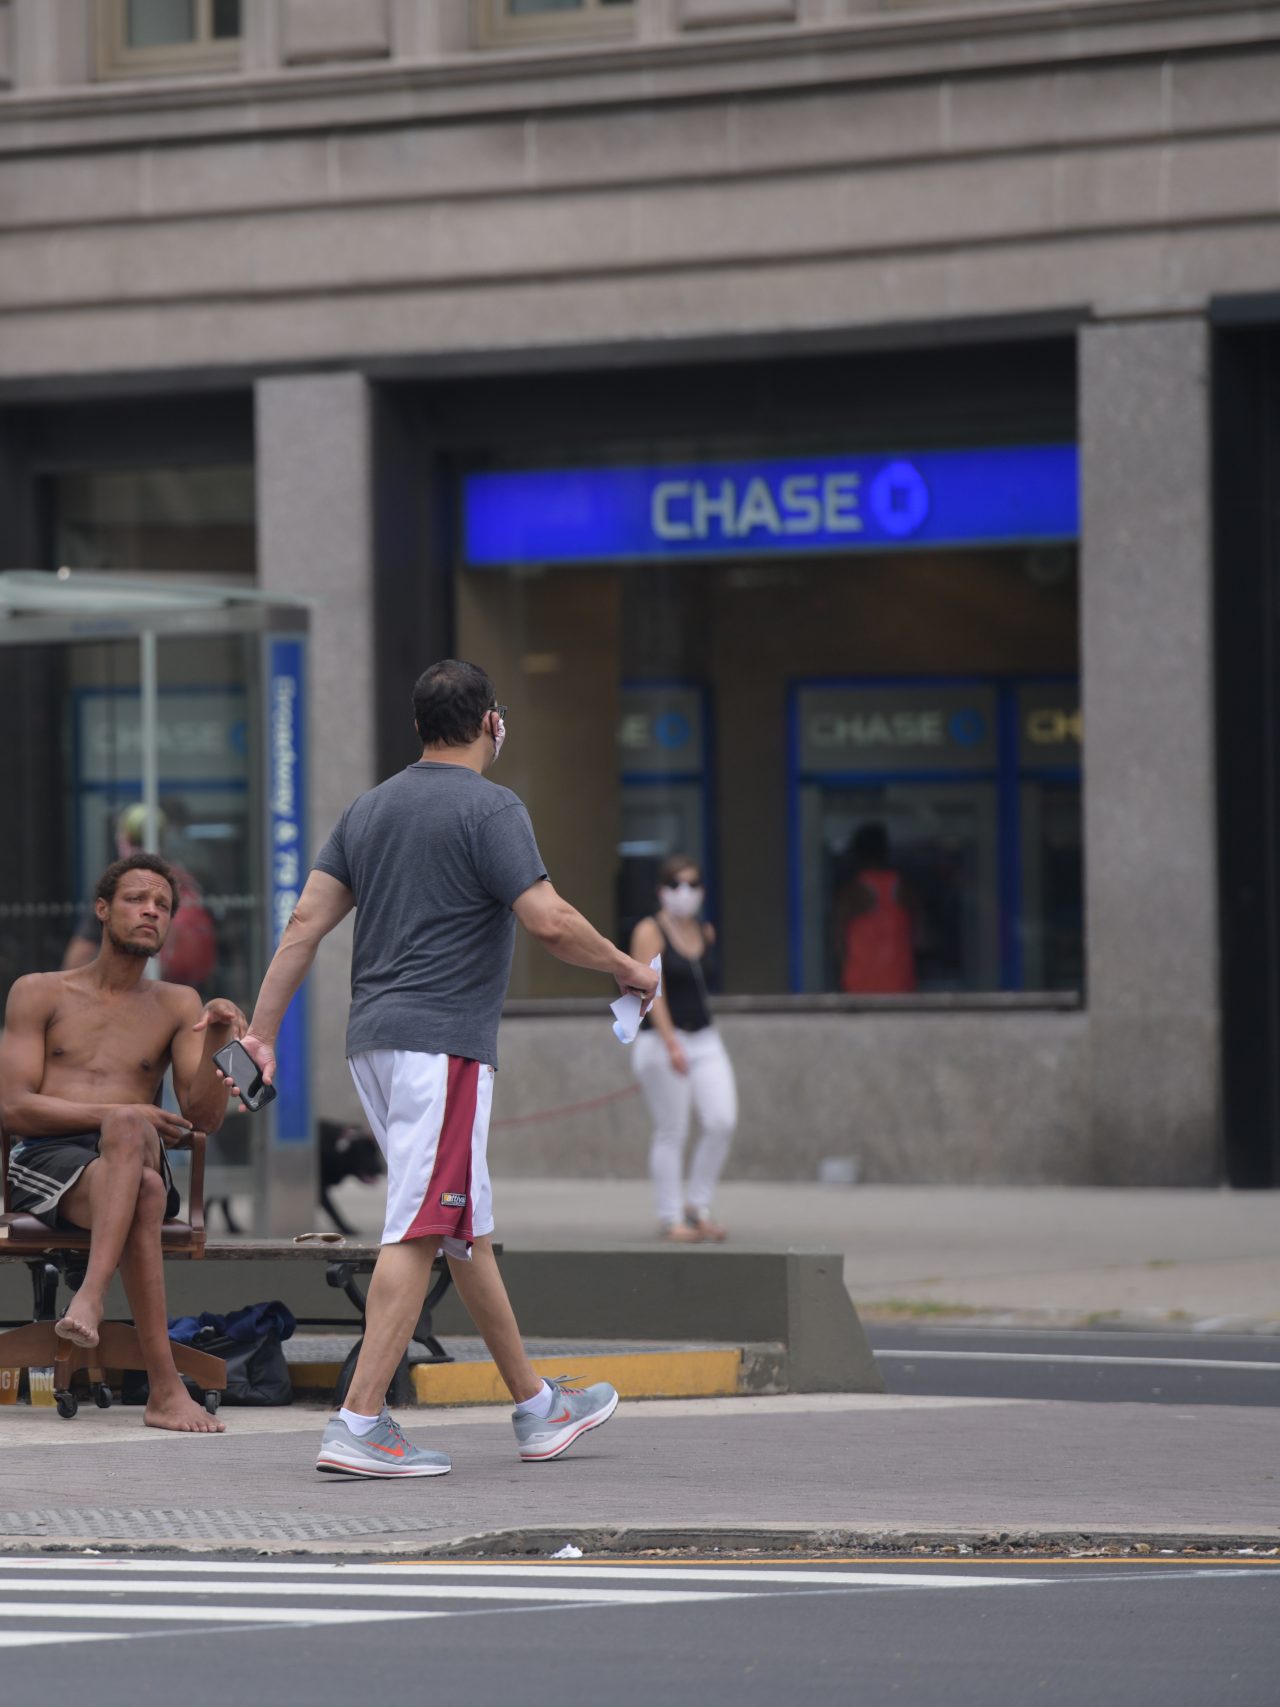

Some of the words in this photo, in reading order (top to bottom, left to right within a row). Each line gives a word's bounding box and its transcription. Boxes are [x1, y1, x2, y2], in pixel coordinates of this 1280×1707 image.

[651, 472, 863, 541] CHASE
[272, 675, 297, 818] Broadway
[810, 711, 945, 747] CHASE
[273, 820, 299, 845] &
[273, 848, 300, 888] 79
